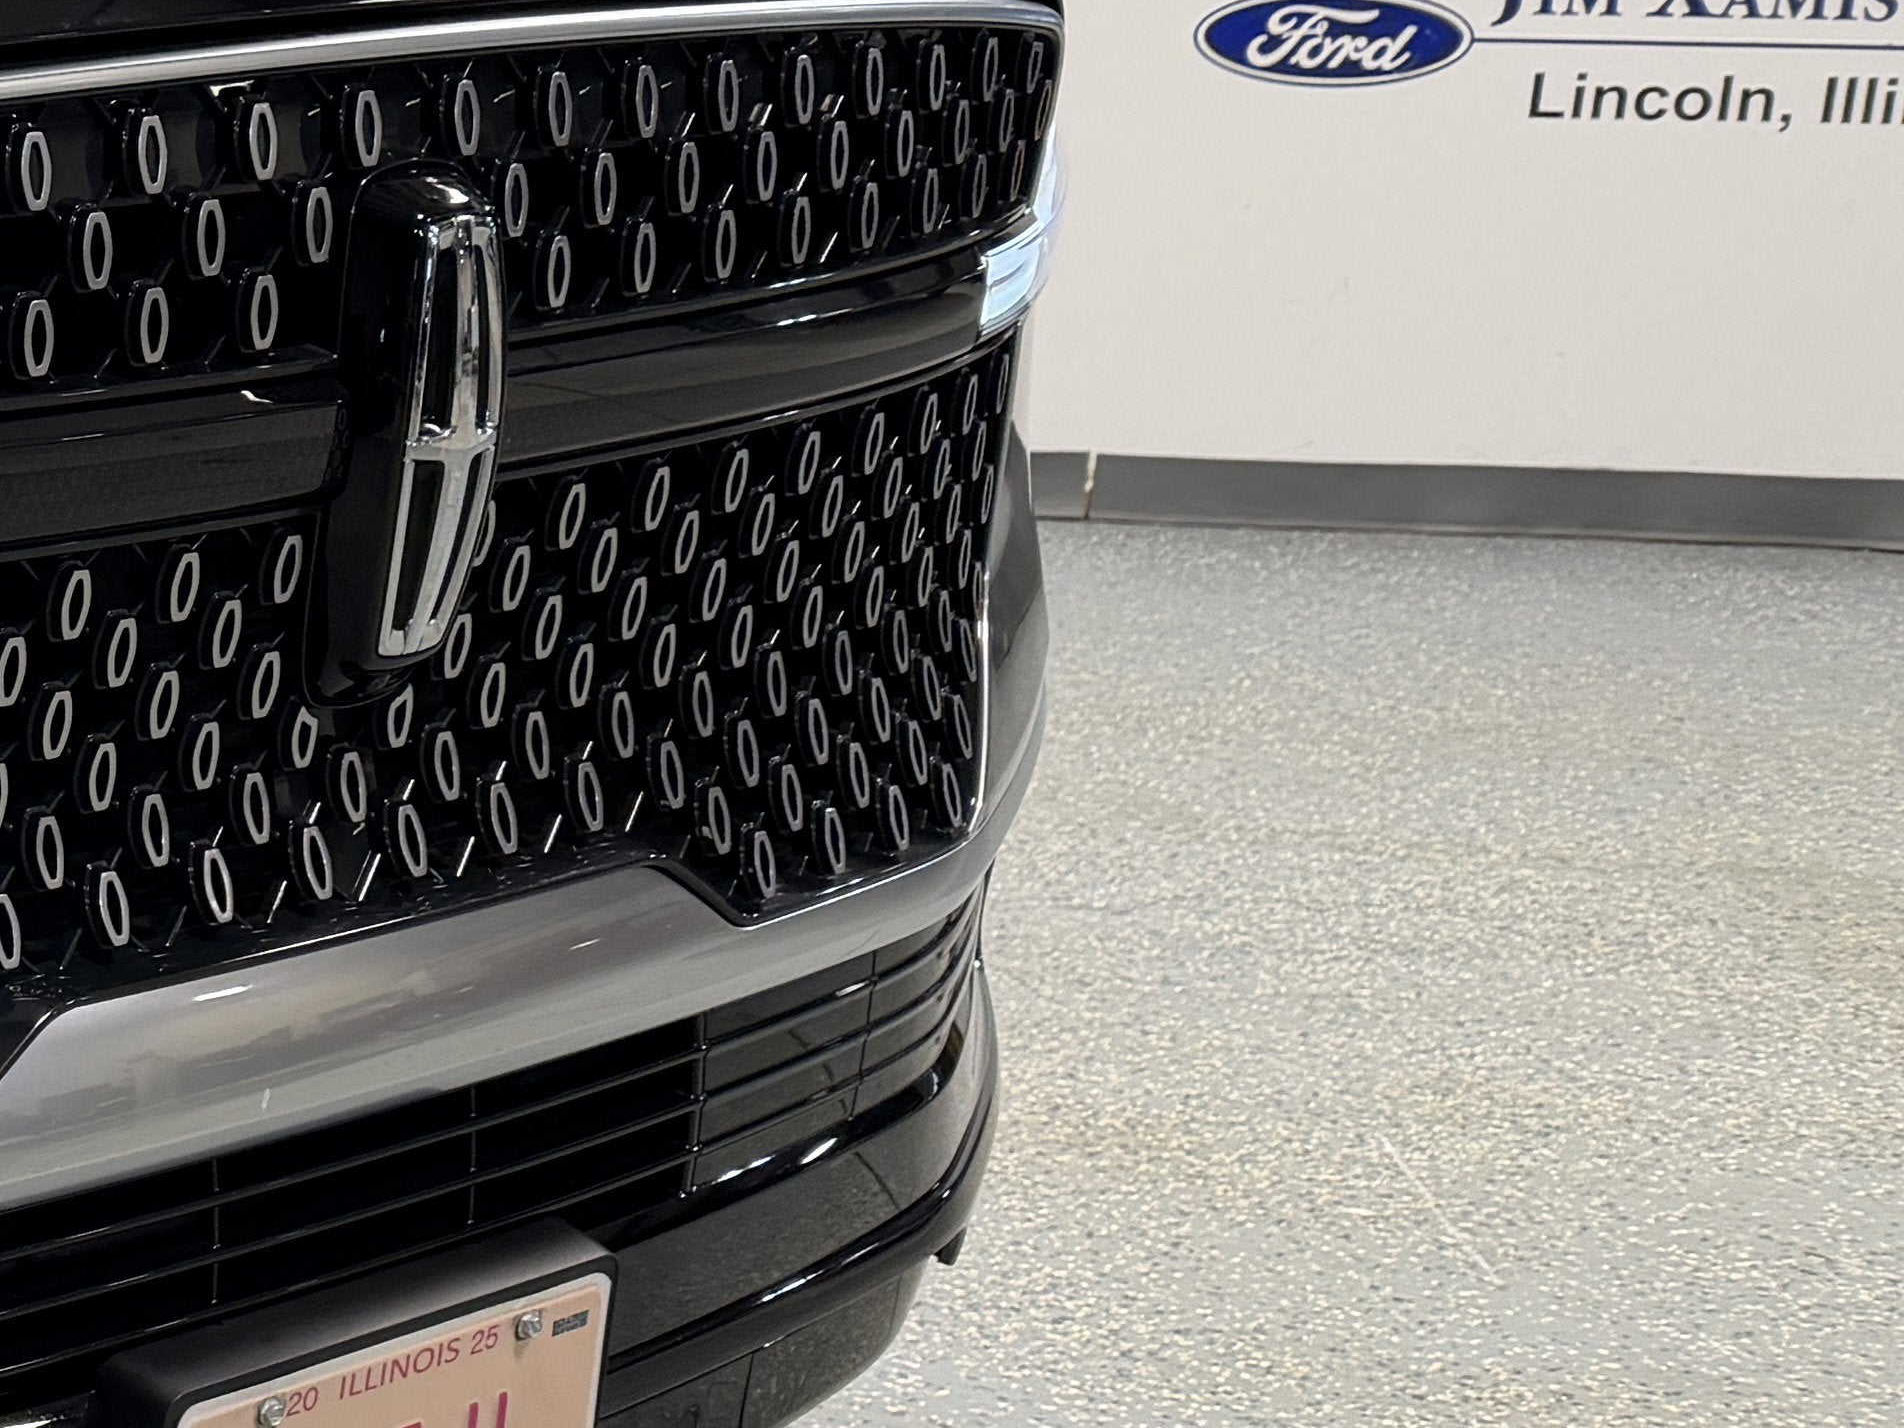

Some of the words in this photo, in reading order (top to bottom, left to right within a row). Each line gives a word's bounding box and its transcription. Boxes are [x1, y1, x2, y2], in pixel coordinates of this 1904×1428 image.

[1246, 4, 1418, 71] Ford
[1528, 72, 1792, 133] Lincoln,
[1820, 76, 1904, 125] Illi
[285, 1387, 319, 1417] 20
[339, 1338, 460, 1400] ILLINOIS
[470, 1325, 500, 1355] 25
